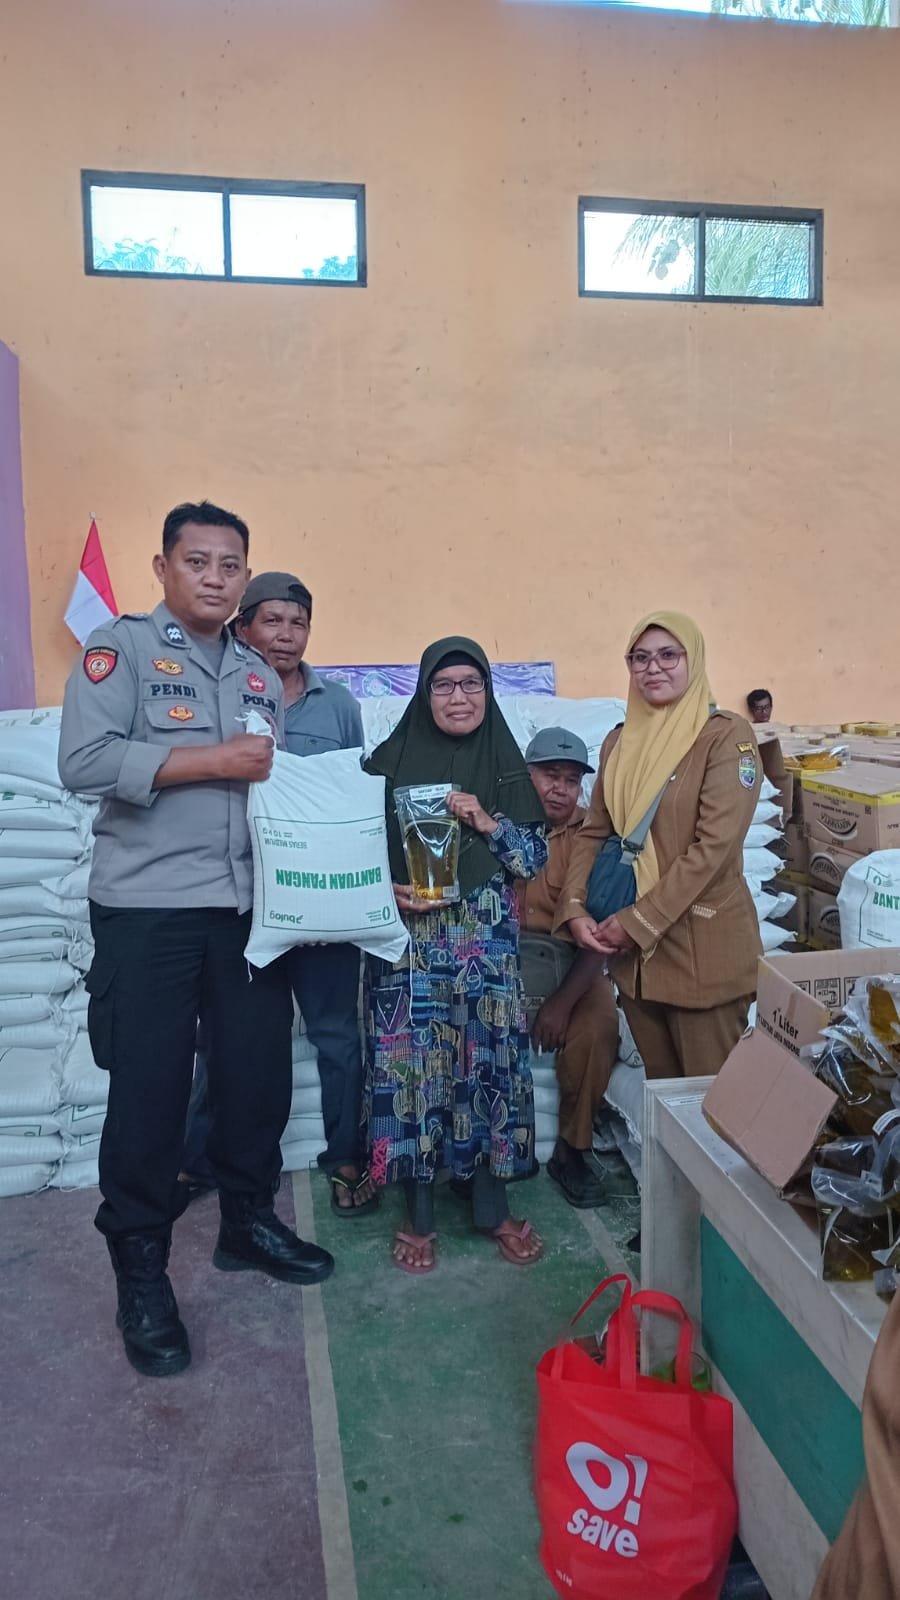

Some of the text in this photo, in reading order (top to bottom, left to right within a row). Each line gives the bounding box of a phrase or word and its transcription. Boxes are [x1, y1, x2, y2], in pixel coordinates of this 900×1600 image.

[150, 683, 197, 698] PENDI
[276, 866, 382, 890] BANTUAN PANGAN
[873, 891, 900, 910] BANT
[269, 910, 296, 924] bulog
[772, 1010, 777, 1024] 1
[778, 1015, 799, 1039] Liter
[566, 1508, 639, 1558] save
